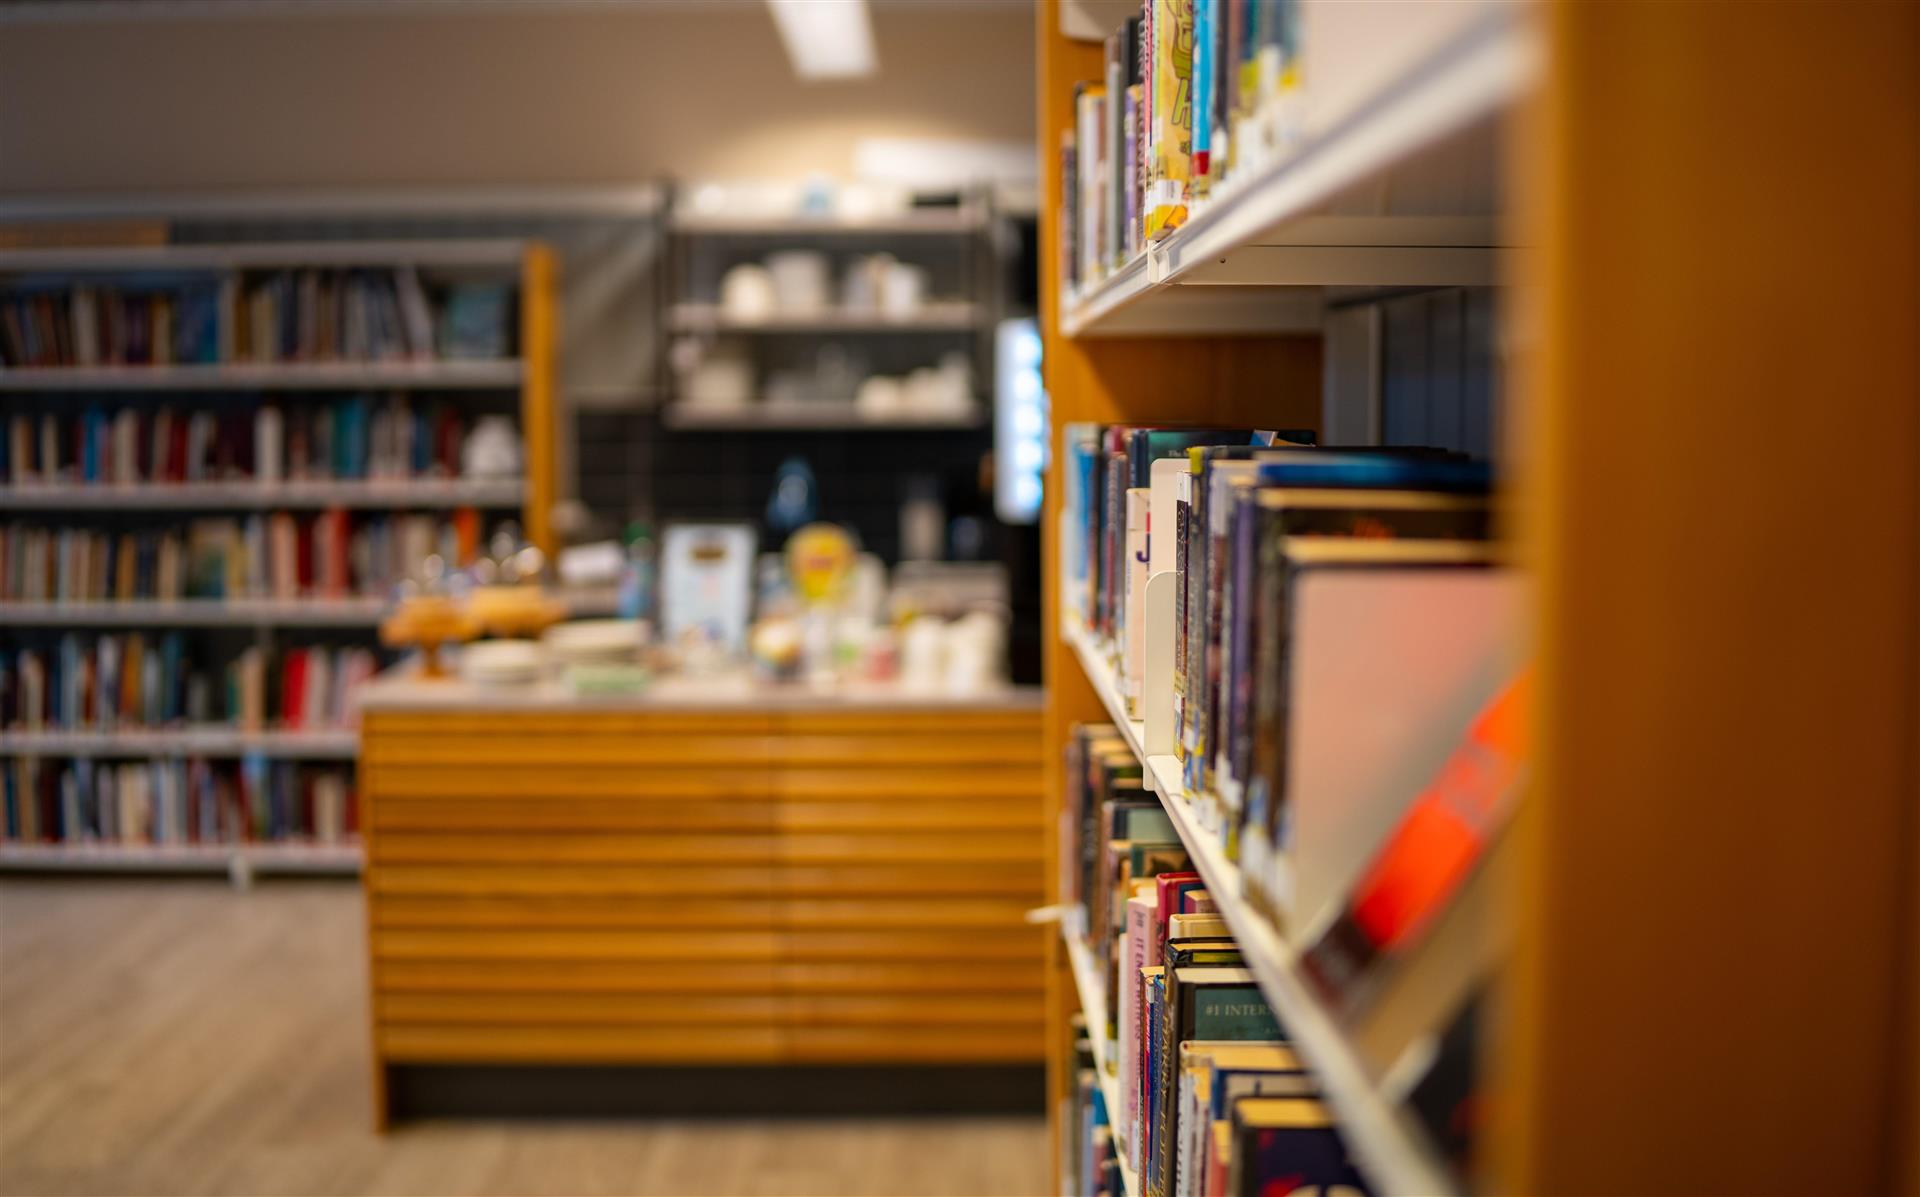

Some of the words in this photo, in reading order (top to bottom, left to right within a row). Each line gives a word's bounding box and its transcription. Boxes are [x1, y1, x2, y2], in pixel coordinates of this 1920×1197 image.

[1135, 937, 1144, 949] IT
[1205, 1004, 1219, 1016] #1
[1161, 1015, 1169, 1099] HARRY
